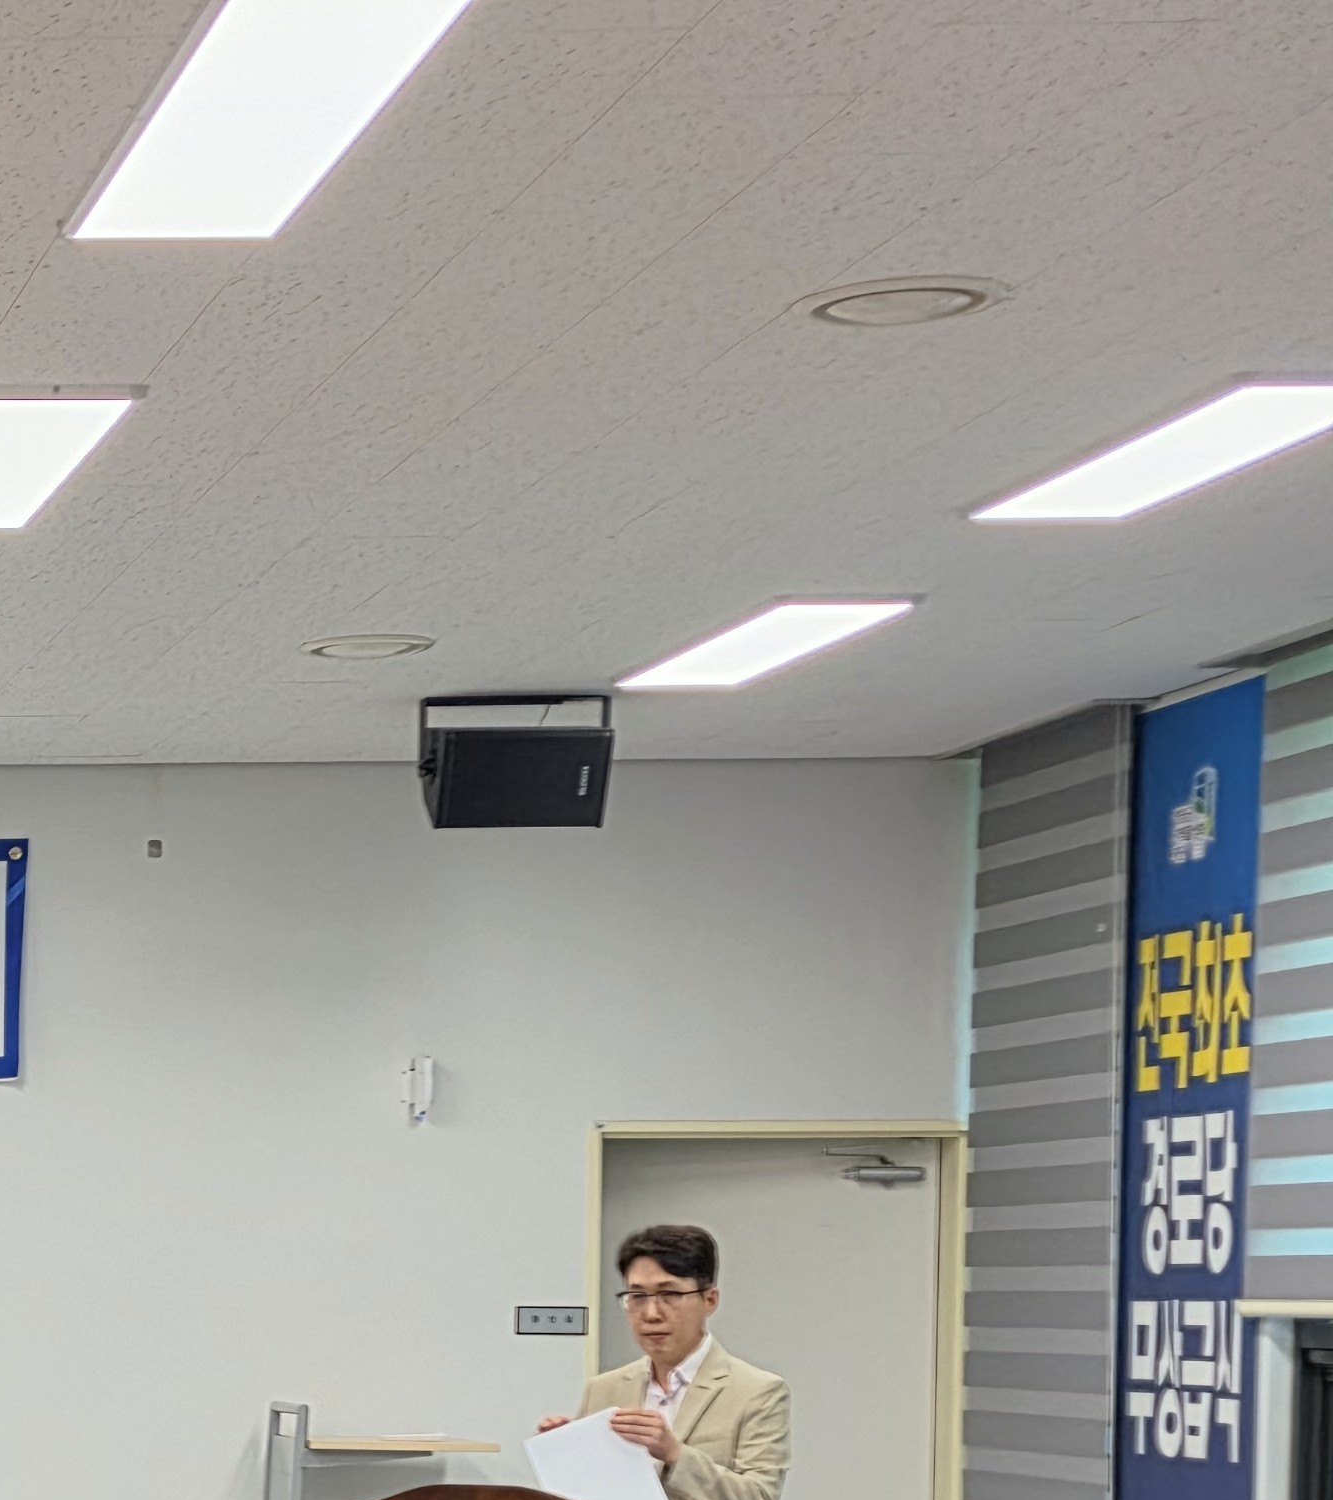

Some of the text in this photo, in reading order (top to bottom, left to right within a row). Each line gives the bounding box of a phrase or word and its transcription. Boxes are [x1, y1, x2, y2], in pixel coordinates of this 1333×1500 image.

[1136, 912, 1253, 1092] 전국최초
[1140, 1109, 1238, 1277] 경로당
[1125, 1298, 1243, 1464] 무상급식
